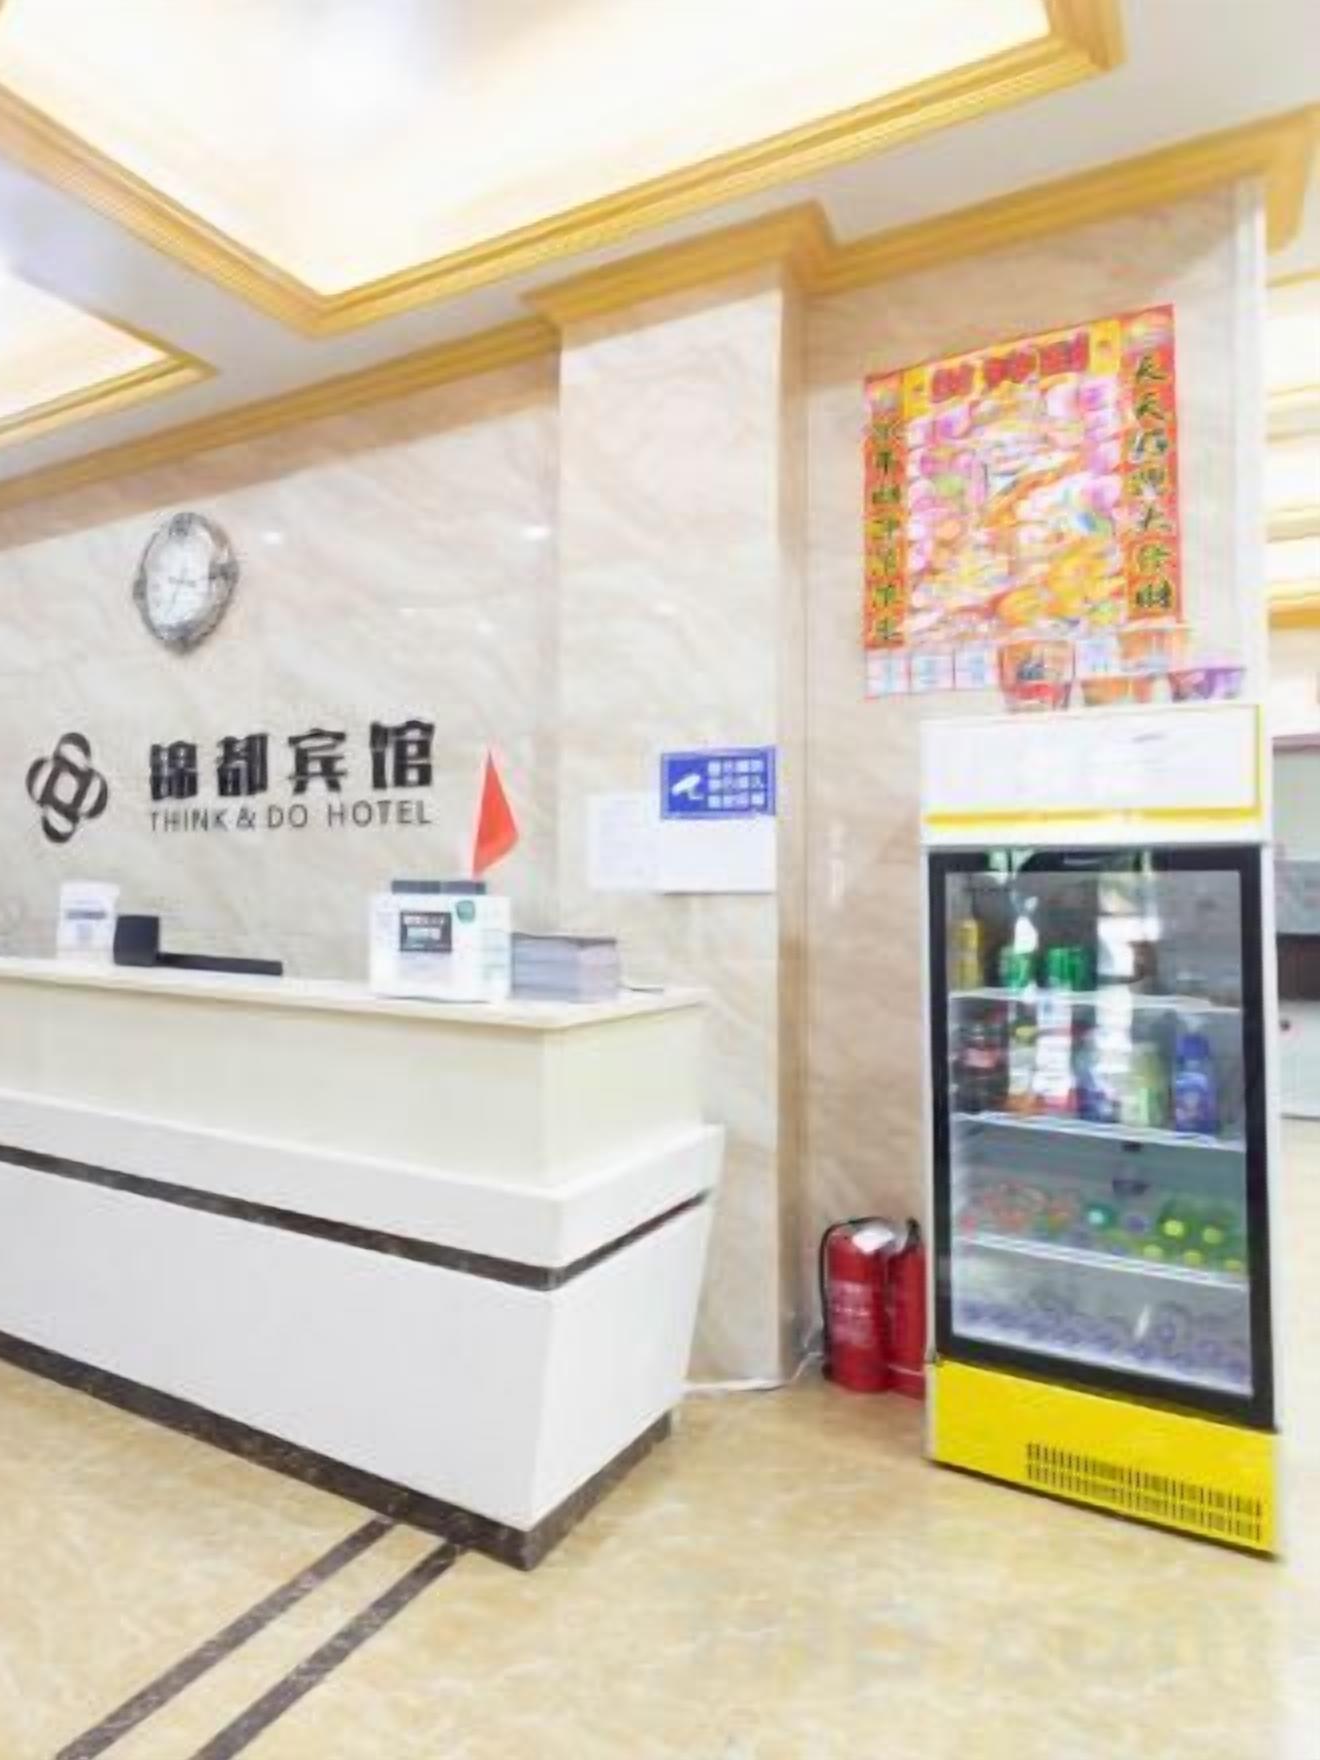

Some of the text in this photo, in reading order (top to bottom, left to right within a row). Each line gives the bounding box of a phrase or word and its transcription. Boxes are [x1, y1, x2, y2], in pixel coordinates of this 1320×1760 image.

[149, 719, 435, 800] 锦都宾馆
[150, 807, 229, 832] THINK
[267, 803, 308, 829] DO
[327, 799, 433, 829] HOTEL
